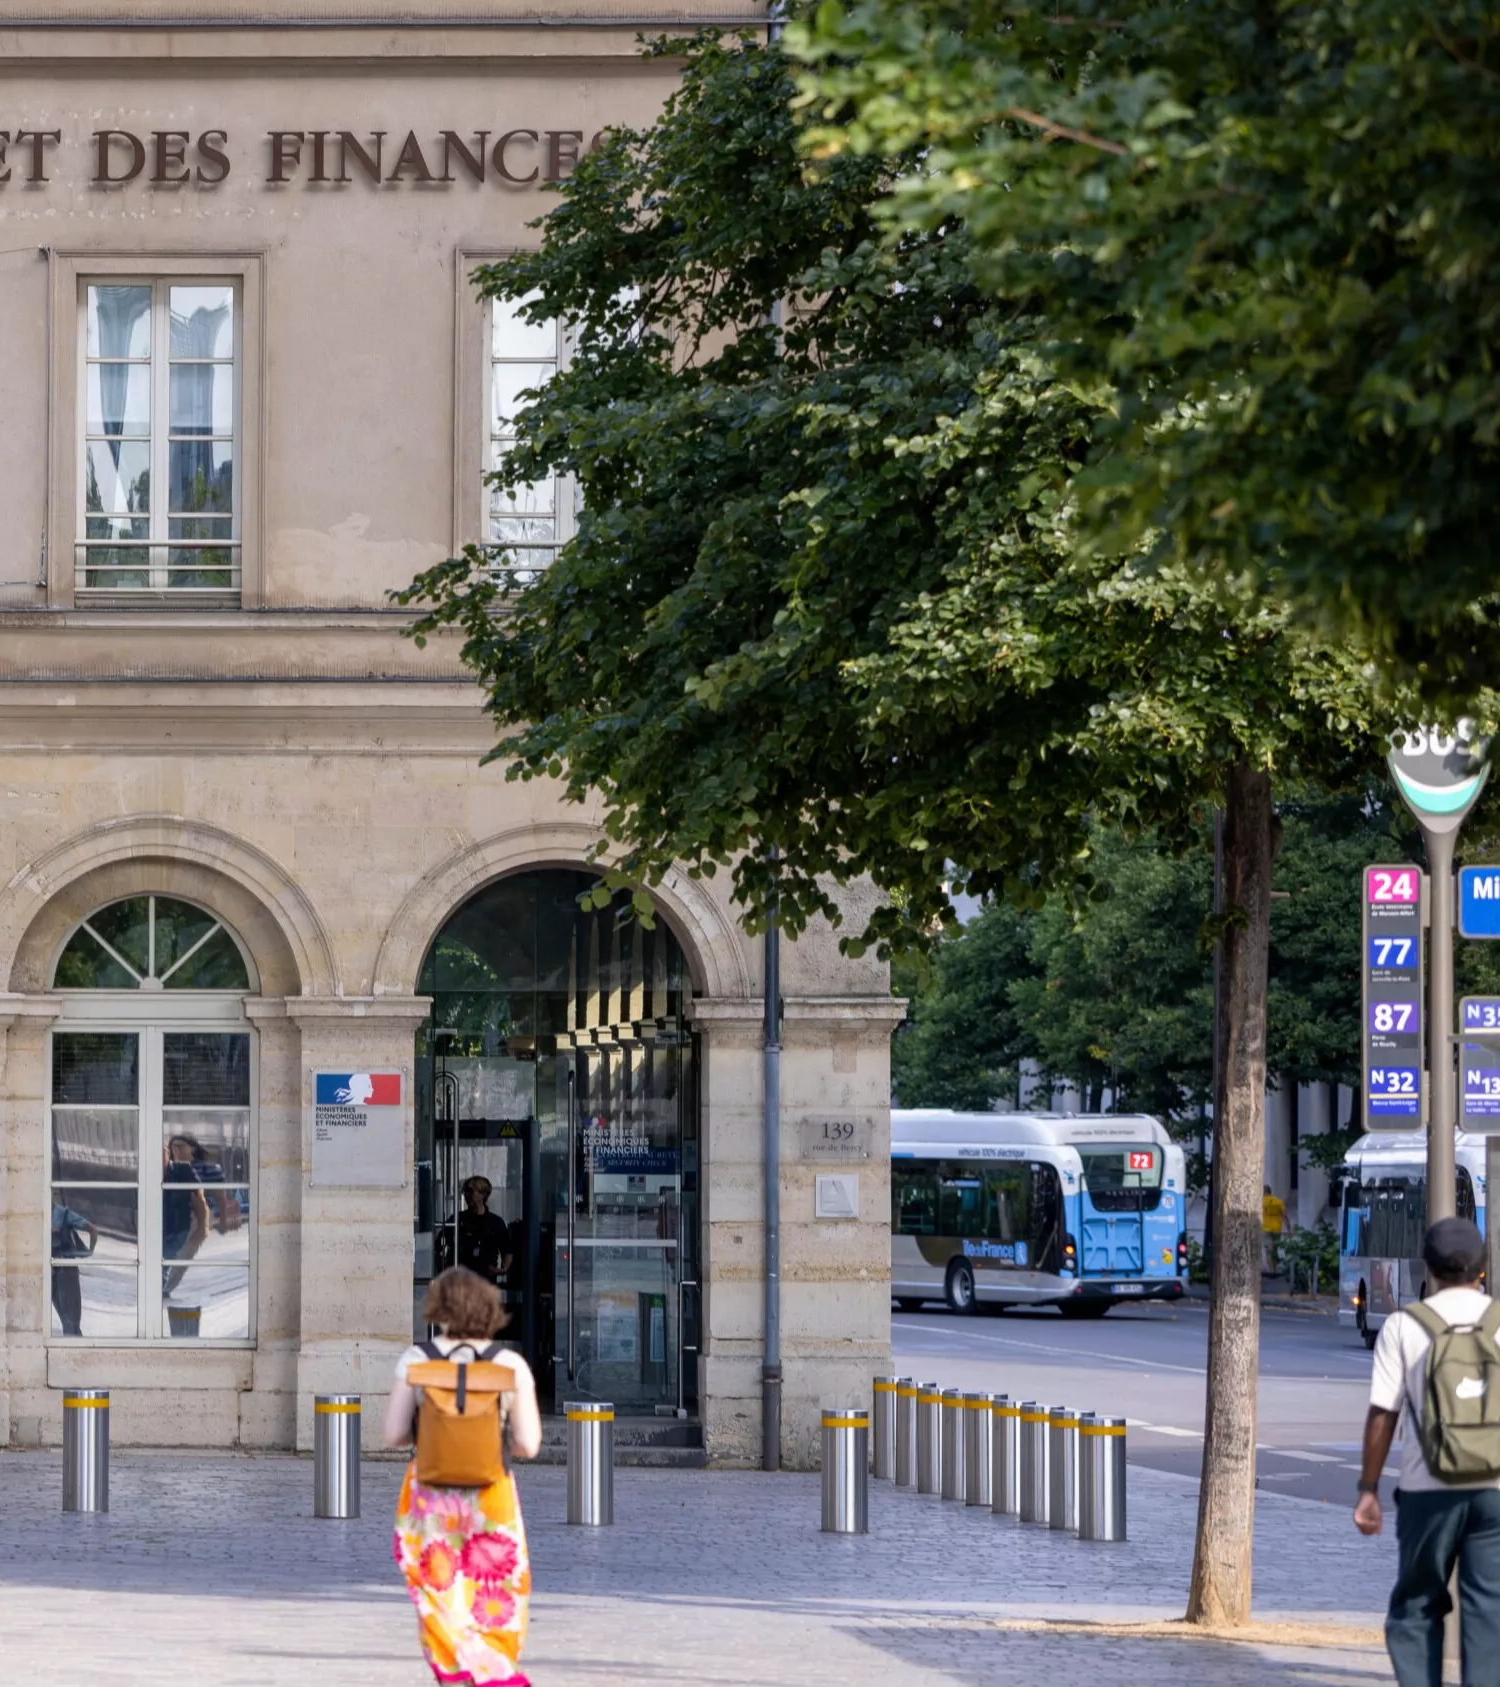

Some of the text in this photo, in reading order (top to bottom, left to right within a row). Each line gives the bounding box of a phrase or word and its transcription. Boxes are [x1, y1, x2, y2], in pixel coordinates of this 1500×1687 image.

[92, 130, 231, 183] DES
[1373, 872, 1414, 900] 24
[1373, 938, 1412, 965] 77
[1374, 1003, 1413, 1032] 87
[822, 1121, 854, 1141] 139
[595, 1146, 649, 1154] FINANCIERS
[1132, 1154, 1150, 1168] 72
